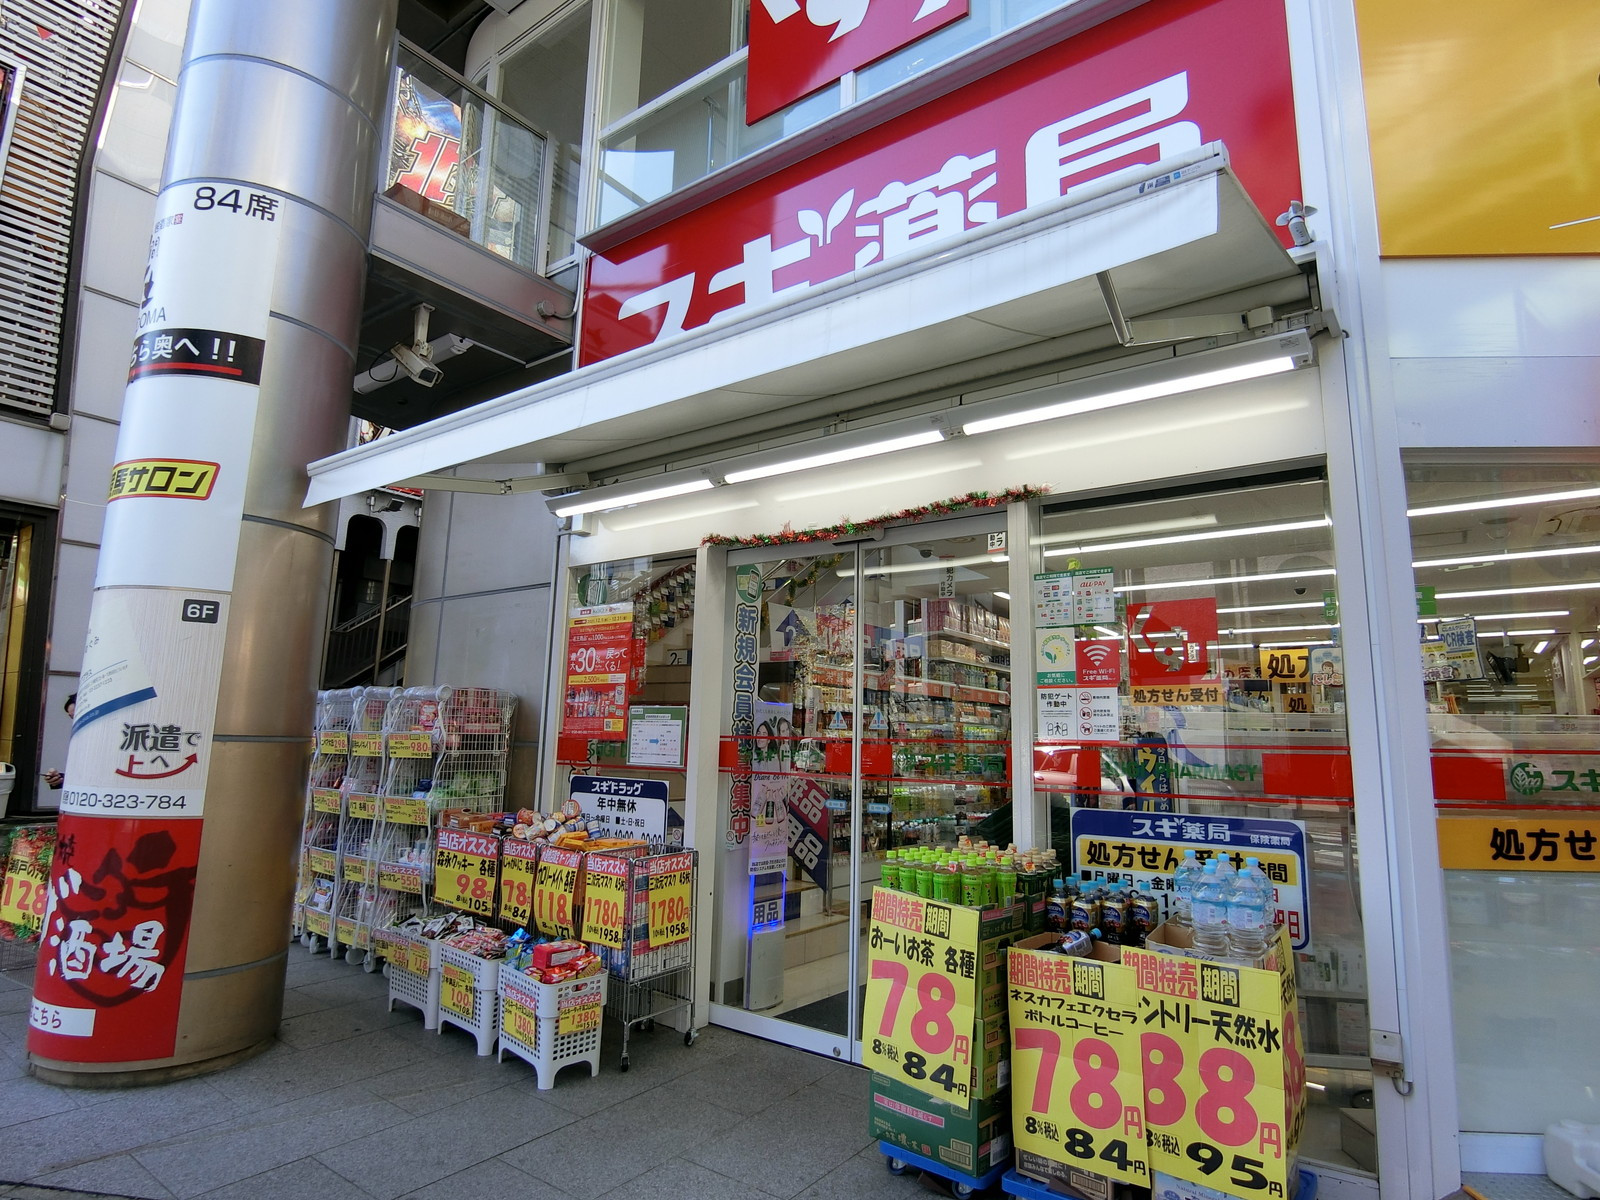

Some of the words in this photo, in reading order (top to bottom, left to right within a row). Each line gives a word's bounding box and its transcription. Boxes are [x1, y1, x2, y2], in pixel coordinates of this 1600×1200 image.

[193, 186, 279, 222] 84席
[186, 603, 215, 619] 6F
[1046, 700, 1067, 708] 作動中
[1133, 687, 1219, 704] 処方せん受付
[120, 722, 202, 751] 派遣で
[127, 755, 169, 776] 上へ
[69, 791, 187, 810] 0120-323-784
[591, 781, 645, 796] スギドラッグ
[597, 797, 637, 813] 年中無休
[438, 831, 498, 857] 当店オススメ
[1132, 817, 1231, 843] スギ薬局
[1249, 834, 1291, 847] 保険薬局
[503, 841, 536, 859] 当店オススメ
[1490, 826, 1598, 863] 処方せ
[436, 851, 475, 872] 森永クッキー
[479, 859, 496, 878] 各種
[587, 856, 626, 877] 当店オススメ
[649, 855, 691, 875] 当店オススメ
[456, 874, 492, 901] 98円
[586, 872, 613, 890] 三次元マスク
[649, 873, 677, 891] 三次元マスク
[586, 896, 624, 930] 1780円
[651, 895, 690, 929] 1780円
[872, 891, 924, 934] 期間特売
[925, 905, 950, 938] 期間
[49, 919, 166, 993] 酒場
[870, 925, 935, 968] おーいお茶
[944, 945, 976, 980] 各種
[1008, 950, 1073, 996] 期間特売
[1073, 962, 1105, 1000] 期間
[1122, 949, 1199, 1001] 期間特売
[1201, 964, 1240, 1008] 期間
[560, 993, 601, 1008] 当店オススメ
[870, 959, 970, 1065] 78円
[1010, 988, 1138, 1025] ネスカフェエクセラ
[30, 1005, 62, 1029] こちら
[1024, 1008, 1124, 1038] ボトルコーヒー
[1138, 995, 1281, 1054] ントリー天然水
[872, 1038, 900, 1063] 8%税込
[902, 1050, 968, 1099] 84円
[1014, 1027, 1144, 1140] 78円
[1139, 1031, 1282, 1160] 88円
[1024, 1115, 1060, 1143] 8%税込
[1063, 1127, 1147, 1177] 84円
[1185, 1141, 1284, 1198] 95円
